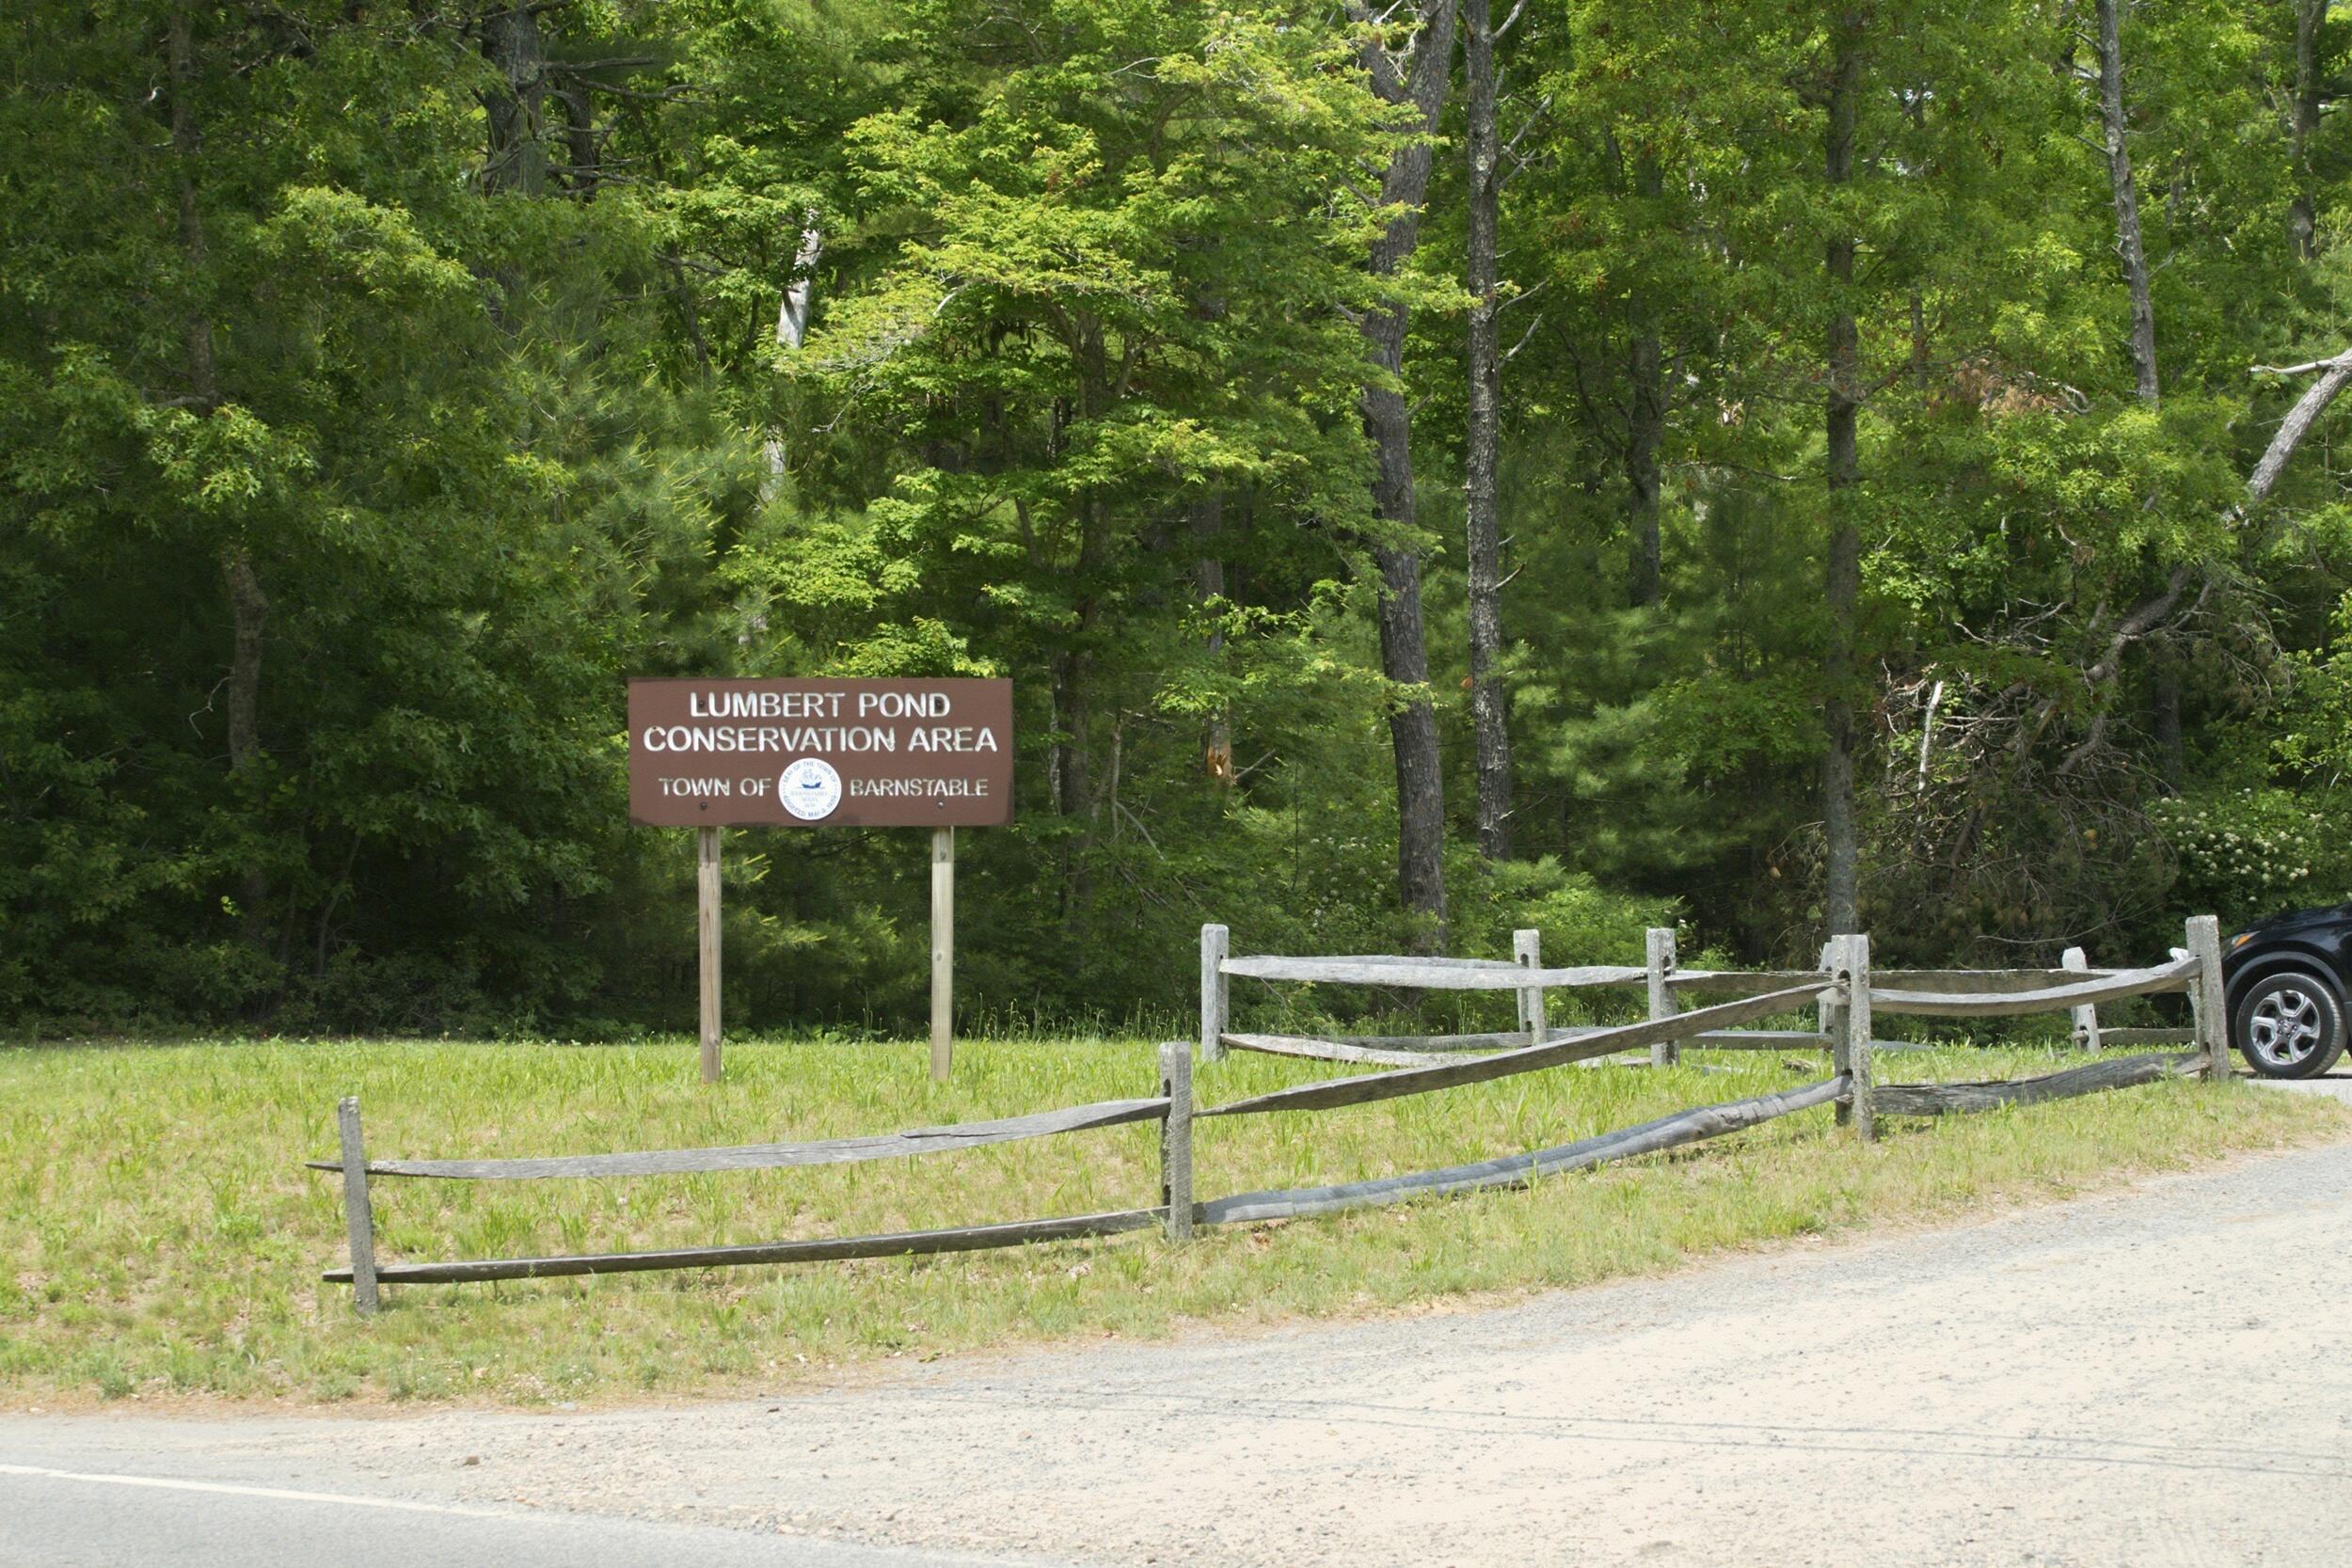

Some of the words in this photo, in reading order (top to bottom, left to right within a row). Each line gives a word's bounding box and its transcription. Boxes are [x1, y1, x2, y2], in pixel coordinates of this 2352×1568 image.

[690, 692, 846, 718] LUMBERT
[859, 692, 951, 718] POND
[644, 726, 896, 752] CONSERVATION
[908, 727, 998, 752] AREA
[659, 778, 730, 798] TOWN
[739, 778, 771, 797] OF
[850, 778, 989, 797] BARNSTABLE
